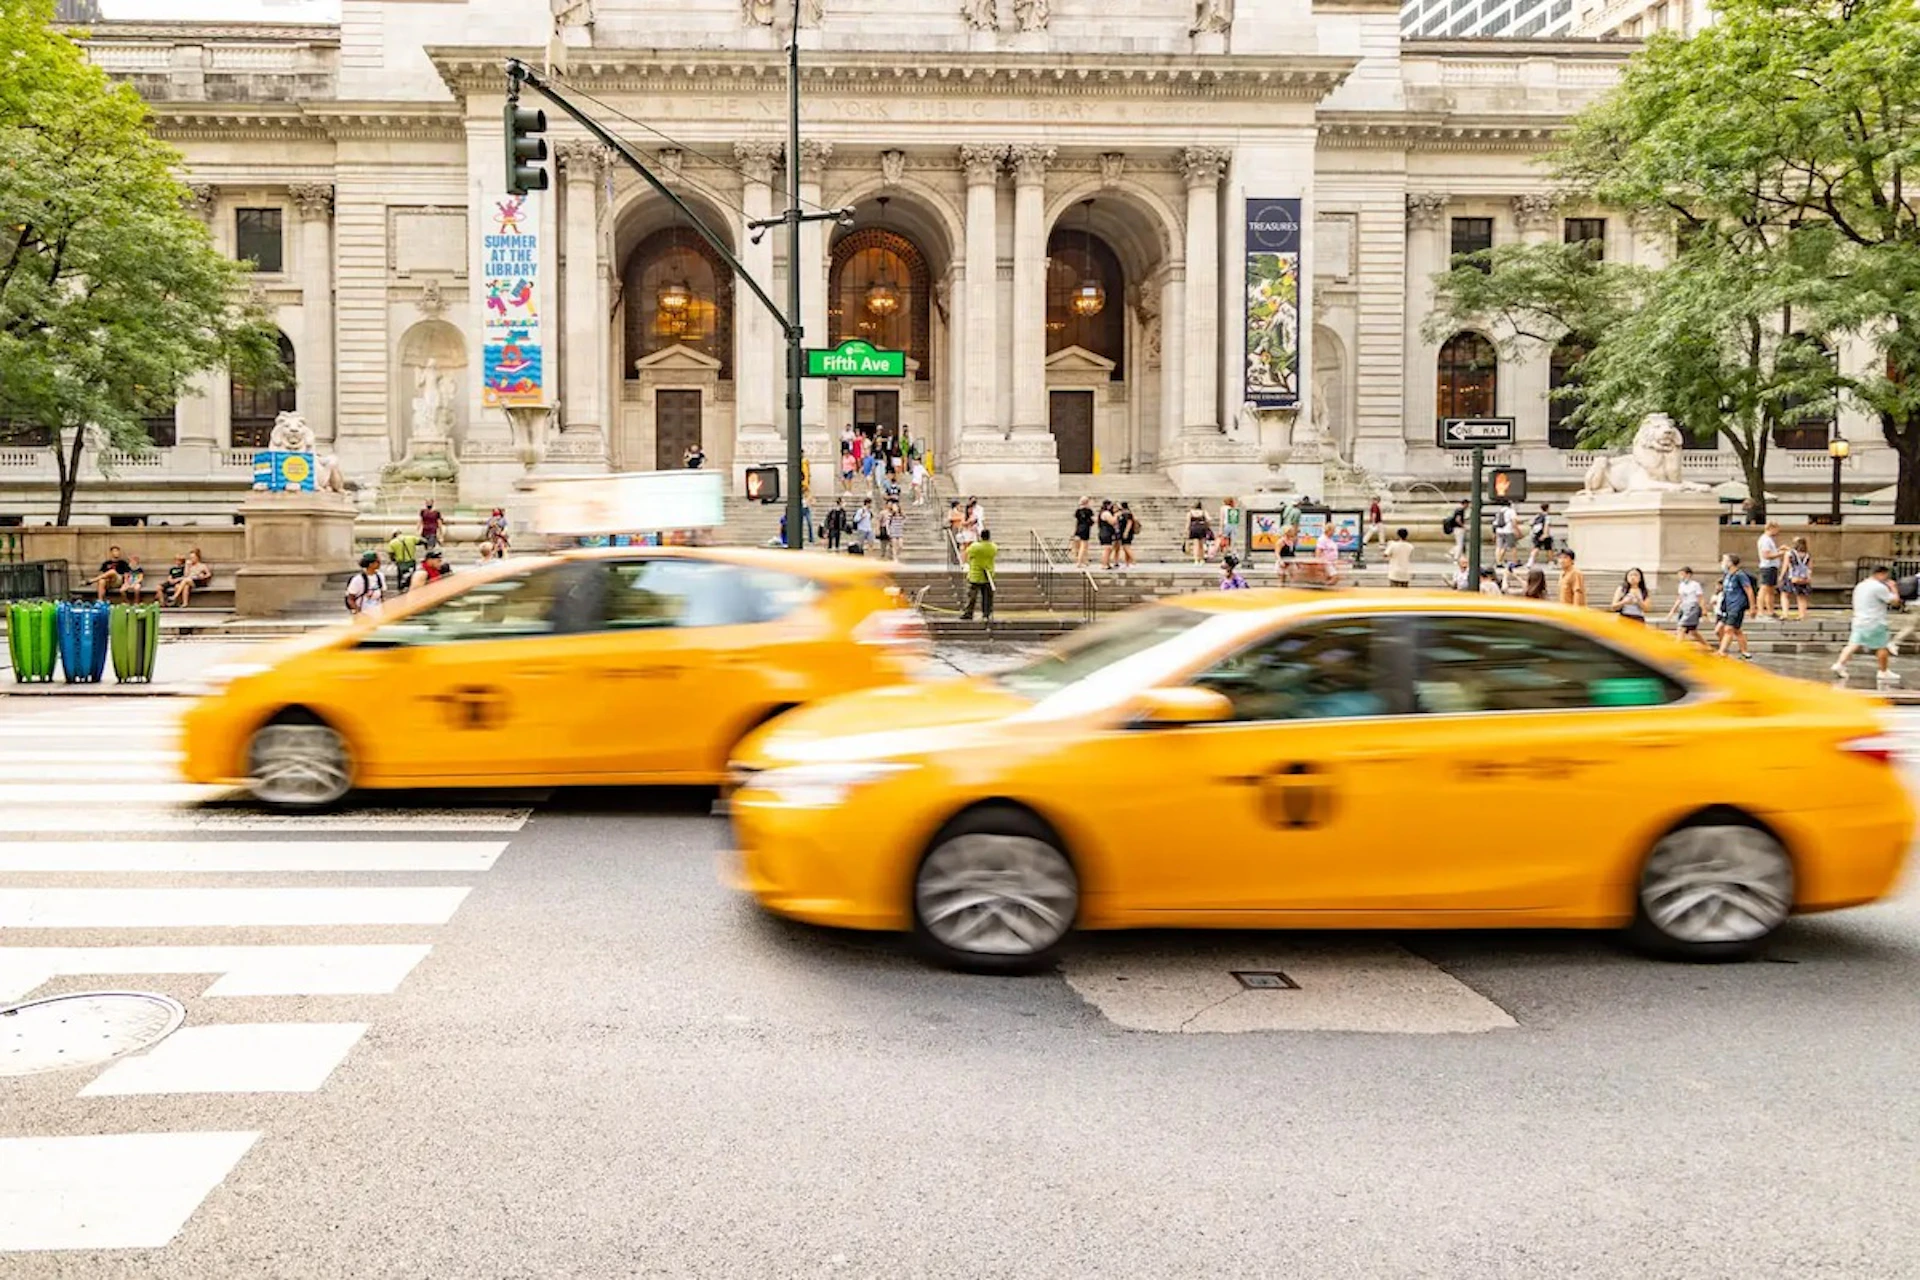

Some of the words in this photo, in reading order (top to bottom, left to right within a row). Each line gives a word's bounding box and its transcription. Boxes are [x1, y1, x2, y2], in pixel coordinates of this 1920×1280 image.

[692, 99, 739, 116] THE
[831, 99, 889, 117] YORK
[907, 100, 986, 118] PUBLIC
[1006, 101, 1099, 119] LIBRARY
[1248, 221, 1298, 231] TREASURES
[485, 235, 537, 248] SUMMER
[491, 249, 505, 261] AT
[510, 249, 533, 261] THE
[485, 263, 537, 276] LIBRARY
[823, 355, 858, 371] Fifth
[861, 356, 890, 372] Ave
[1456, 426, 1473, 436] ONE
[1483, 426, 1502, 435] WAY
